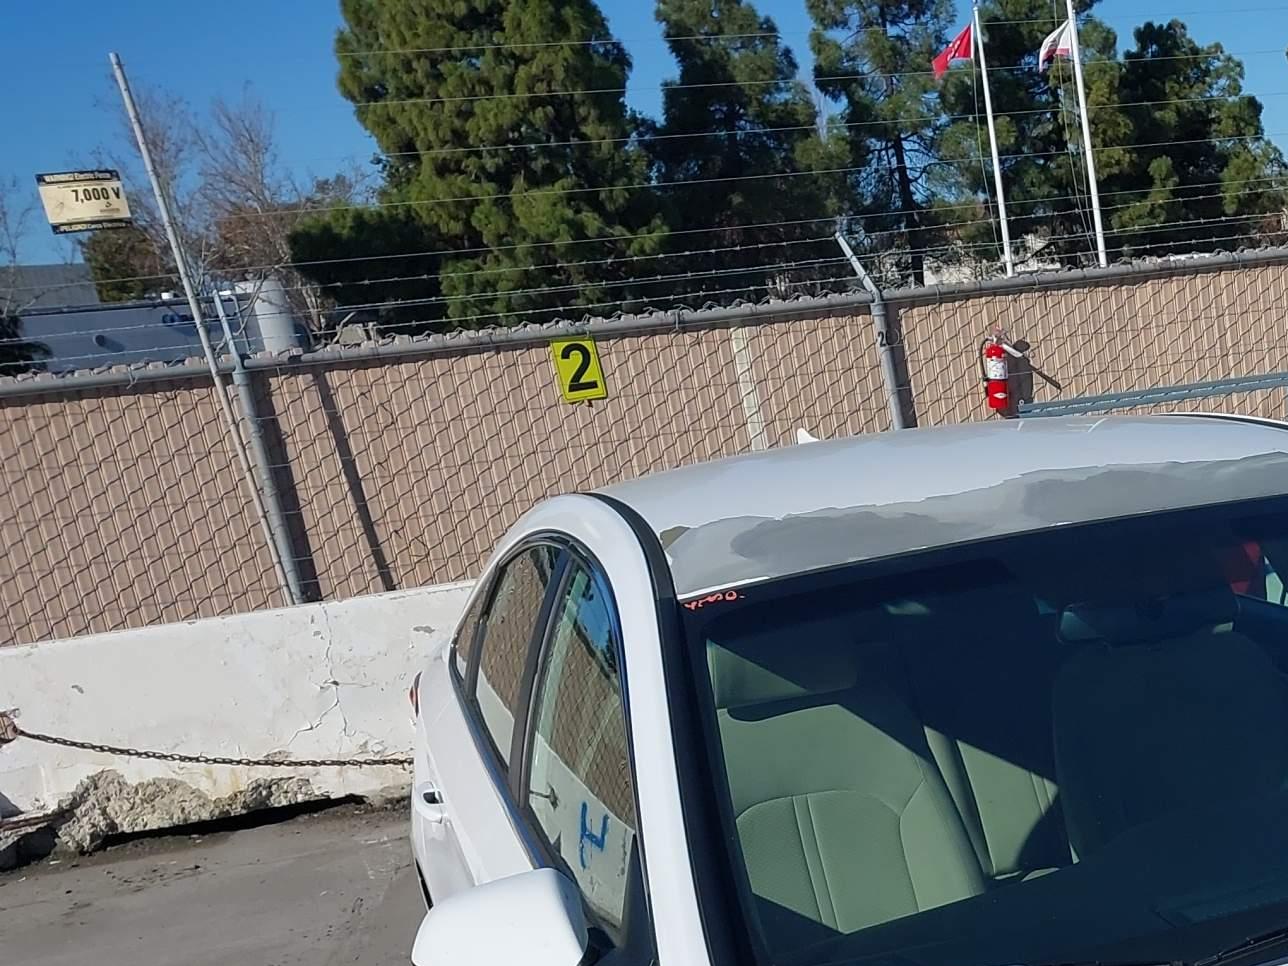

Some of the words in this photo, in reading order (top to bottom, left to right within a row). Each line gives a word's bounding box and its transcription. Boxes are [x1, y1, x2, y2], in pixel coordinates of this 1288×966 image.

[71, 187, 110, 204] 7,000
[111, 187, 121, 199] V
[561, 342, 598, 393] 2
